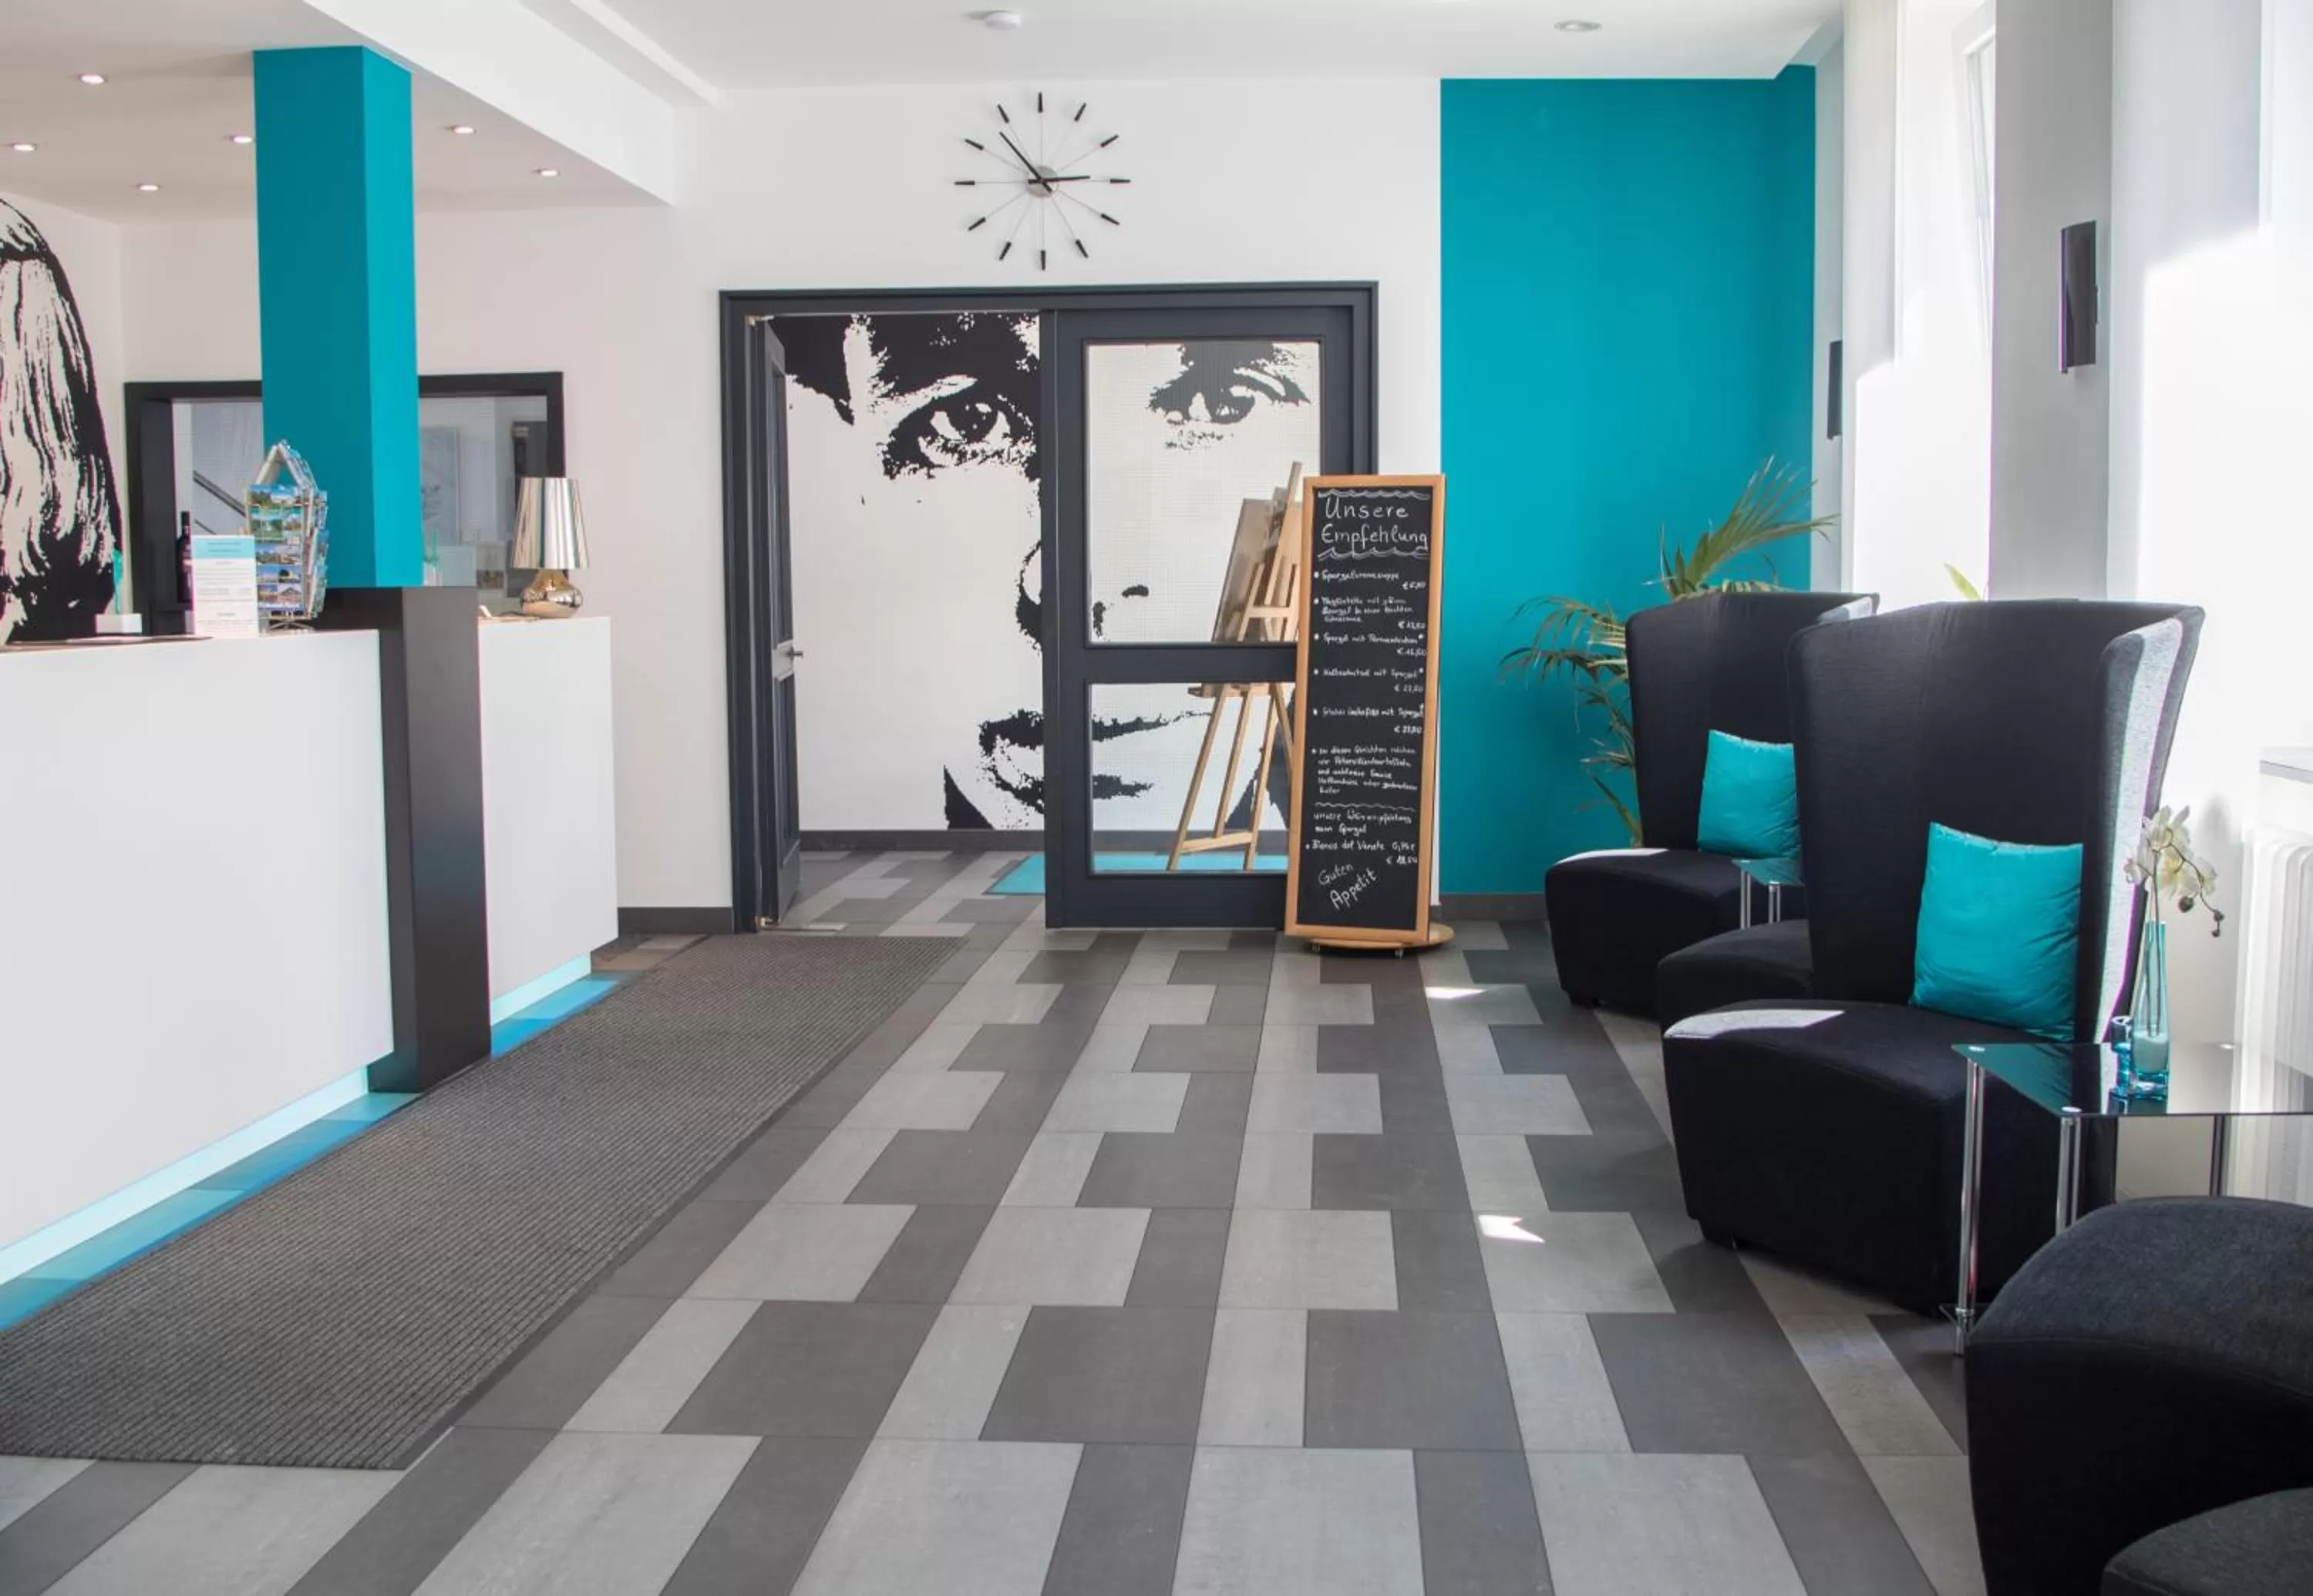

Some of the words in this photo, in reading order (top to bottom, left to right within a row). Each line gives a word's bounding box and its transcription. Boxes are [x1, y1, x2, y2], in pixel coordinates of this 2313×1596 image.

[1325, 496, 1409, 519] Unsere
[1321, 523, 1428, 554] Empfehlung
[1323, 631, 1348, 645] Spargel
[1381, 707, 1395, 716] mit
[1338, 823, 1367, 837] Spargel
[1318, 864, 1355, 885] Guten
[1330, 867, 1377, 911] Appetit
